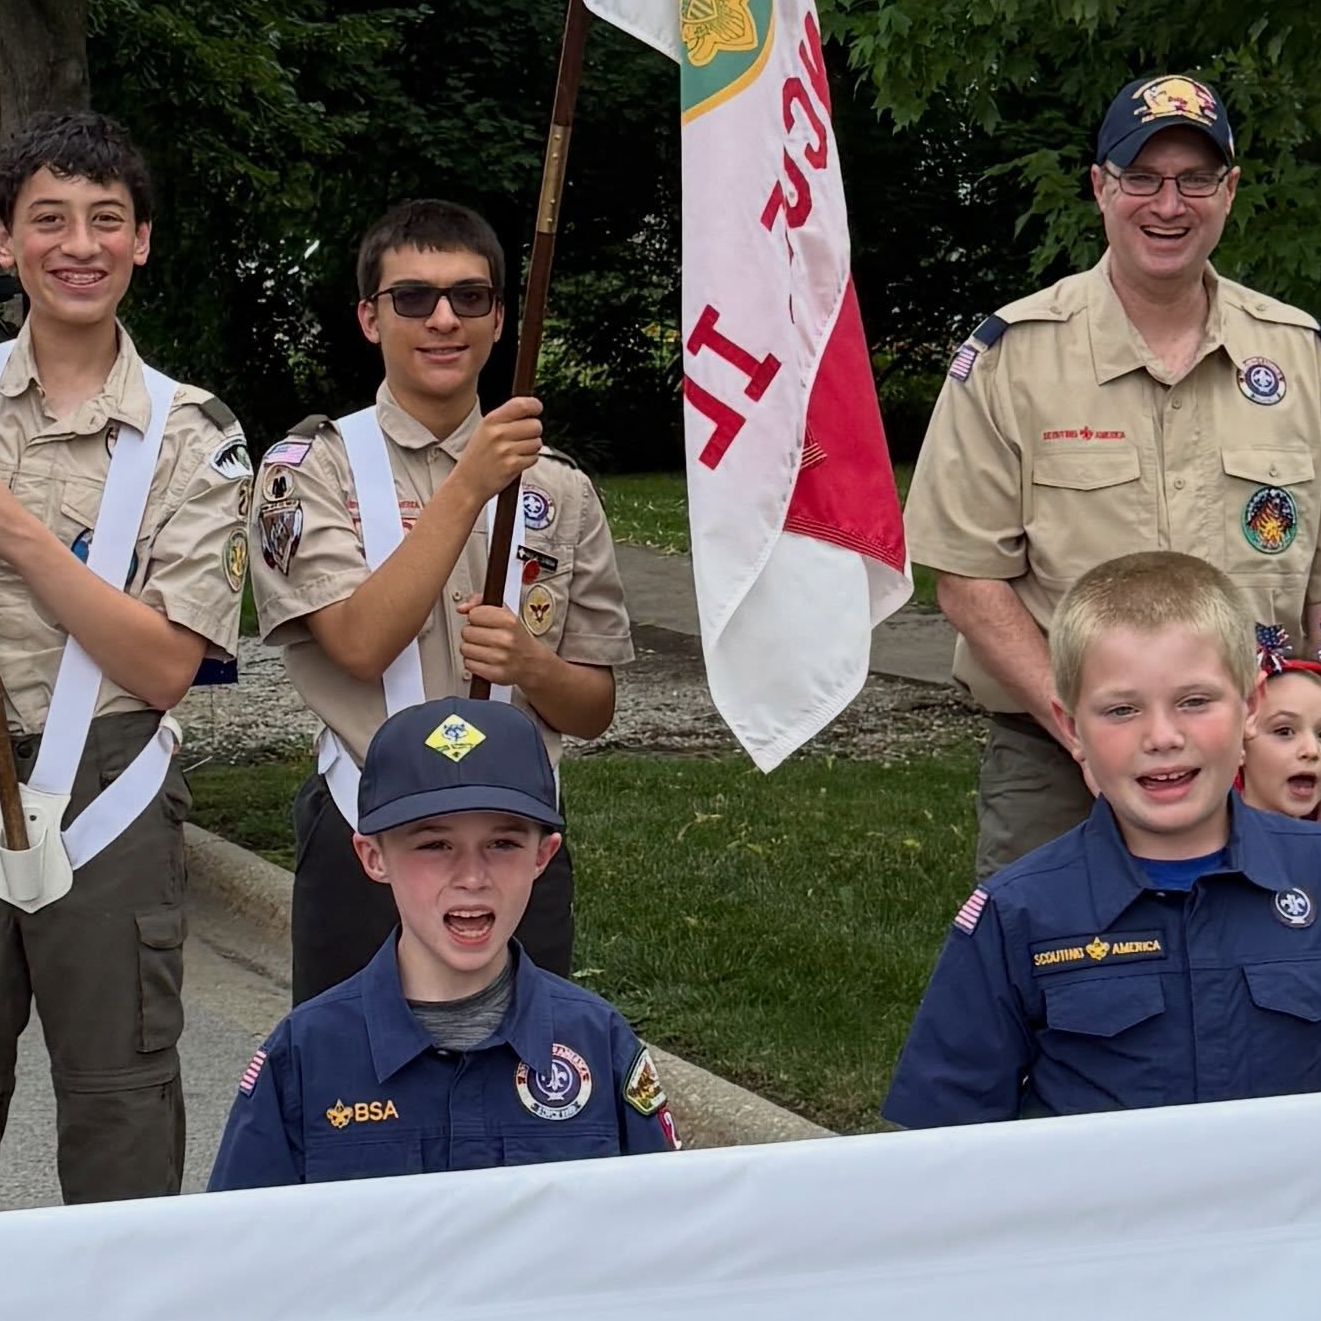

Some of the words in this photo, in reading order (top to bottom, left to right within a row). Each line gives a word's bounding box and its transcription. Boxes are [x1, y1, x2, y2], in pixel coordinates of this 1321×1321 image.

[1033, 946, 1085, 967] SCOUTING
[1111, 939, 1162, 955] AMERICA
[354, 1099, 400, 1122] BSA
